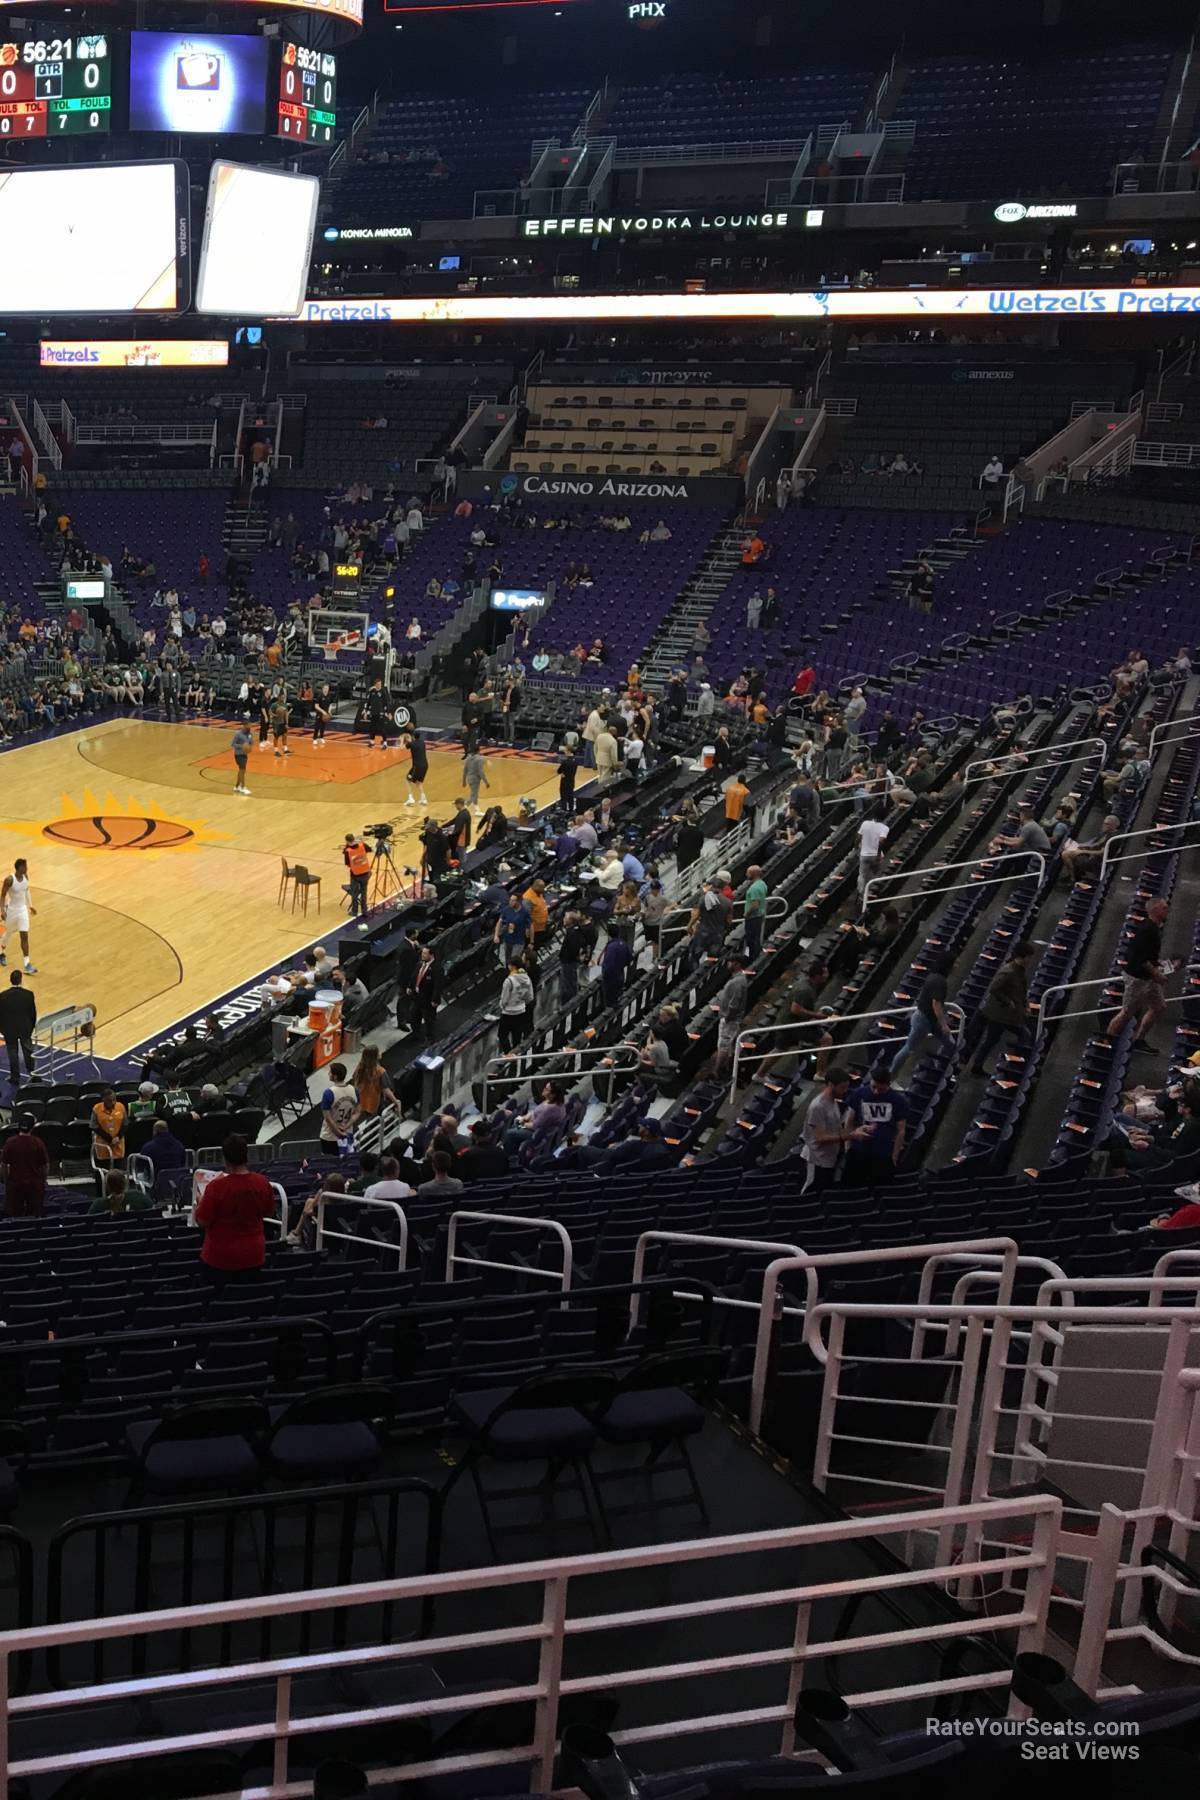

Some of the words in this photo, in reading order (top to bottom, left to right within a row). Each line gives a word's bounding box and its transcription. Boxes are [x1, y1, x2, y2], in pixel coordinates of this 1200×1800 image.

[629, 2, 665, 17] PHX
[23, 38, 72, 62] 56:21
[298, 46, 321, 71] 56:21
[38, 63, 61, 75] QTR
[2, 70, 17, 95] 0
[84, 63, 100, 88] 0
[44, 79, 51, 93] 1
[286, 70, 295, 95] 0
[324, 81, 332, 104] 0
[305, 87, 311, 101] 1
[25, 103, 42, 112] TOL
[53, 100, 70, 109] TOL
[80, 97, 109, 108] FOULS
[1, 118, 10, 132] 0
[26, 116, 35, 131] 7
[59, 114, 68, 129] 7
[90, 112, 99, 127] 0
[284, 117, 290, 132] 0
[296, 120, 302, 135] 7
[311, 123, 317, 137] 7
[325, 127, 331, 141] 0
[1002, 207, 1019, 215] FOX
[1025, 205, 1078, 218] ARIZONA
[525, 218, 613, 236] EFFEN
[621, 218, 692, 230] VODKA
[701, 213, 788, 228] LOUNGE
[178, 217, 187, 257] verizon
[340, 228, 373, 239] KONICA
[374, 227, 413, 238] MINOLTA
[989, 291, 1107, 313] Wetzel's
[307, 303, 392, 321] Pretzels
[46, 347, 99, 362] Pretzels
[336, 565, 359, 577] 56:20
[869, 1105, 887, 1118] W
